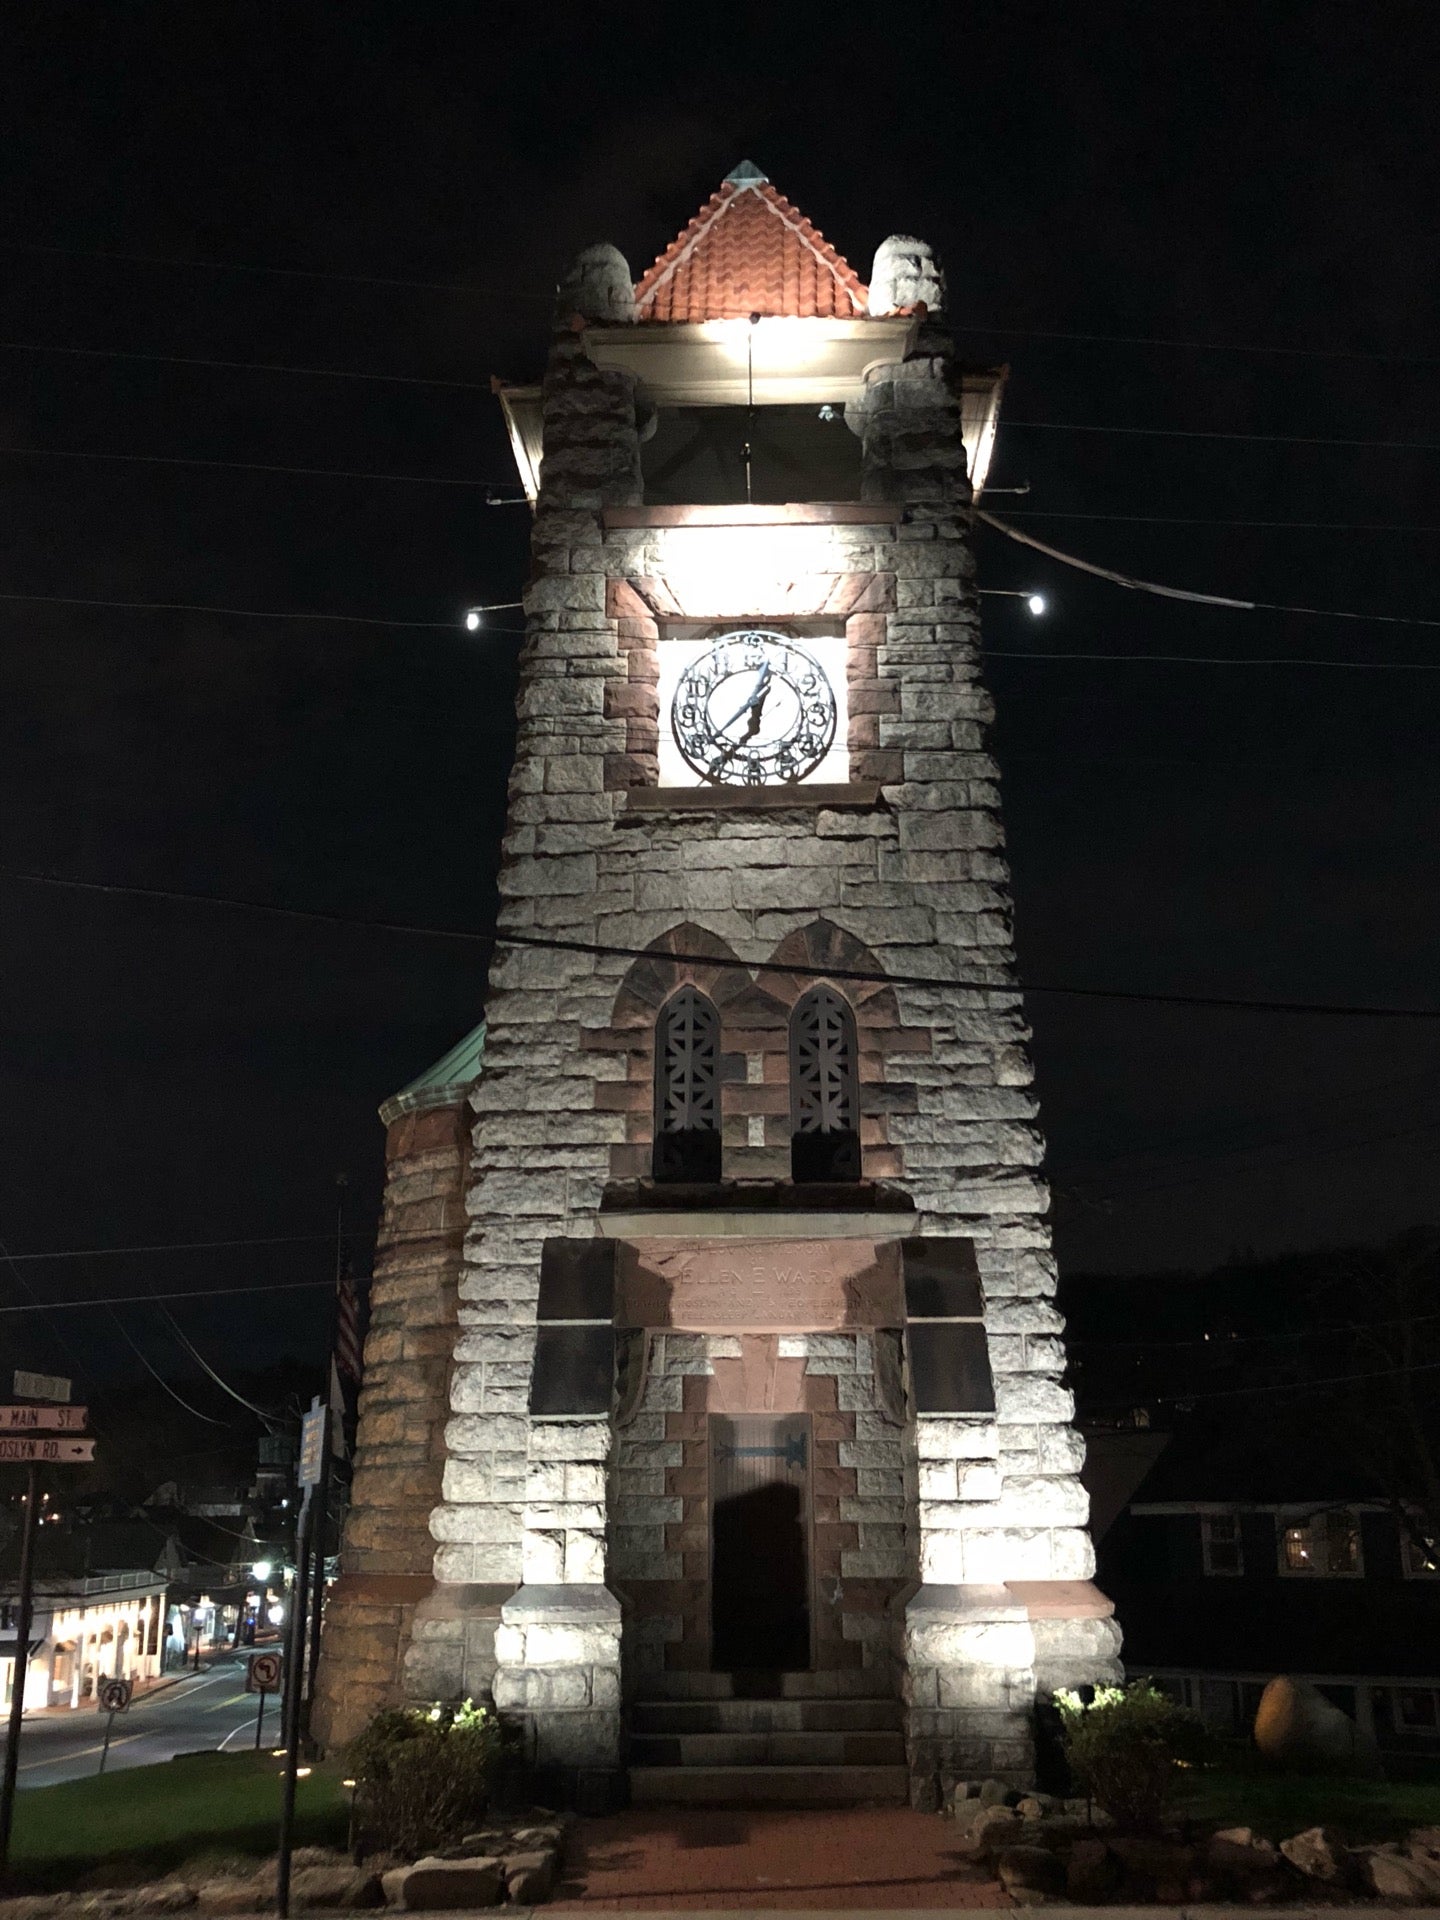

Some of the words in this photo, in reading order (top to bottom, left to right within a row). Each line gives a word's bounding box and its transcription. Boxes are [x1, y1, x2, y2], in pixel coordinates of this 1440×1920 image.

[801, 674, 819, 697] 2
[681, 704, 698, 729] 9
[809, 703, 828, 728] 3
[771, 1242, 832, 1256] MEMORY
[680, 1266, 745, 1285] ELLEN
[771, 1265, 836, 1286] WARD
[10, 1409, 38, 1427] MAIN
[56, 1408, 76, 1427] ST.
[0, 1439, 37, 1458] OSLYN
[42, 1440, 60, 1459] RD.
